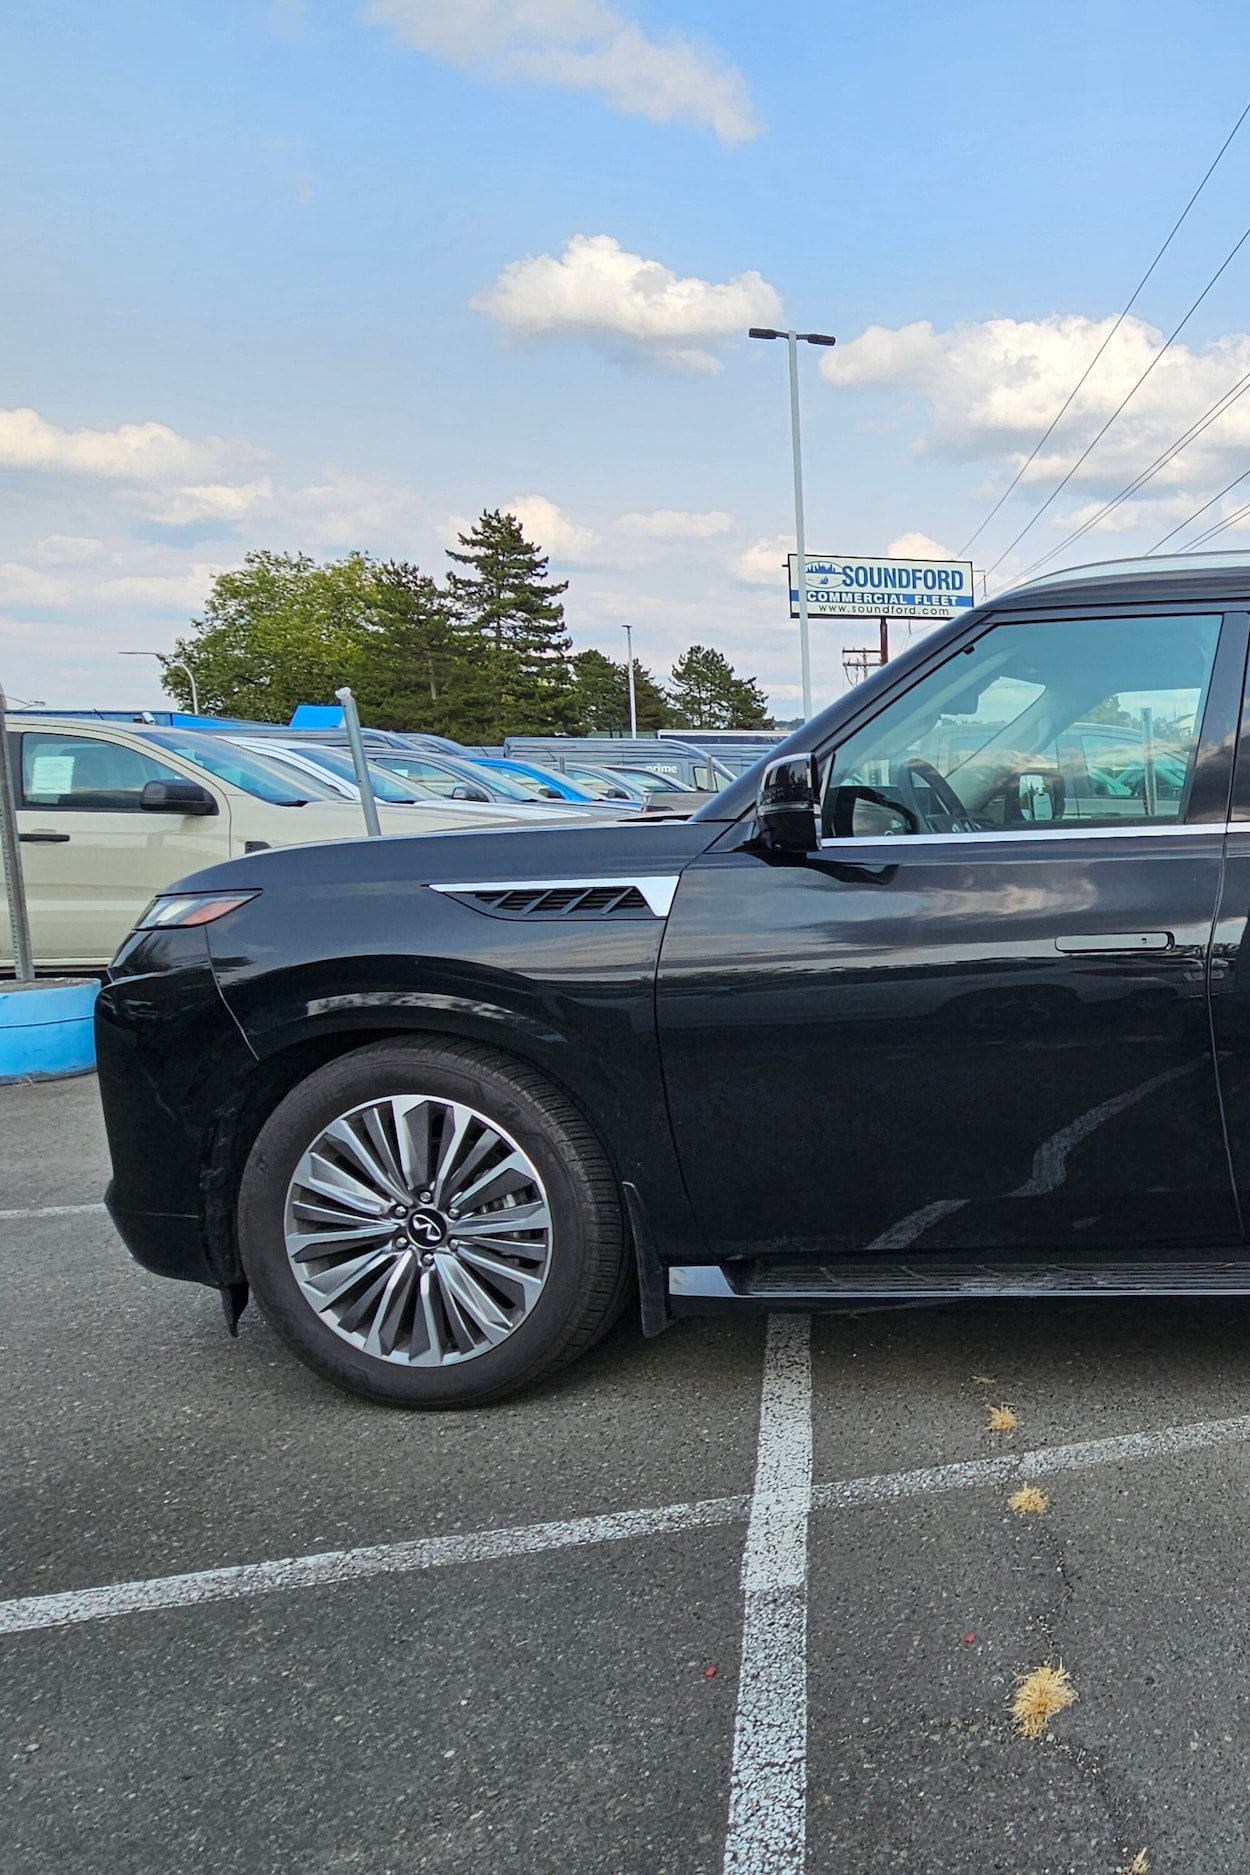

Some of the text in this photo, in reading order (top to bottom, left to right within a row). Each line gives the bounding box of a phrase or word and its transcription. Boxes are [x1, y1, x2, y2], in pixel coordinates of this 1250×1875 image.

[842, 566, 963, 590] SOUNDFORD
[807, 591, 957, 606] COMMERCIAL FLEET
[819, 604, 949, 616] www.soundford.com
